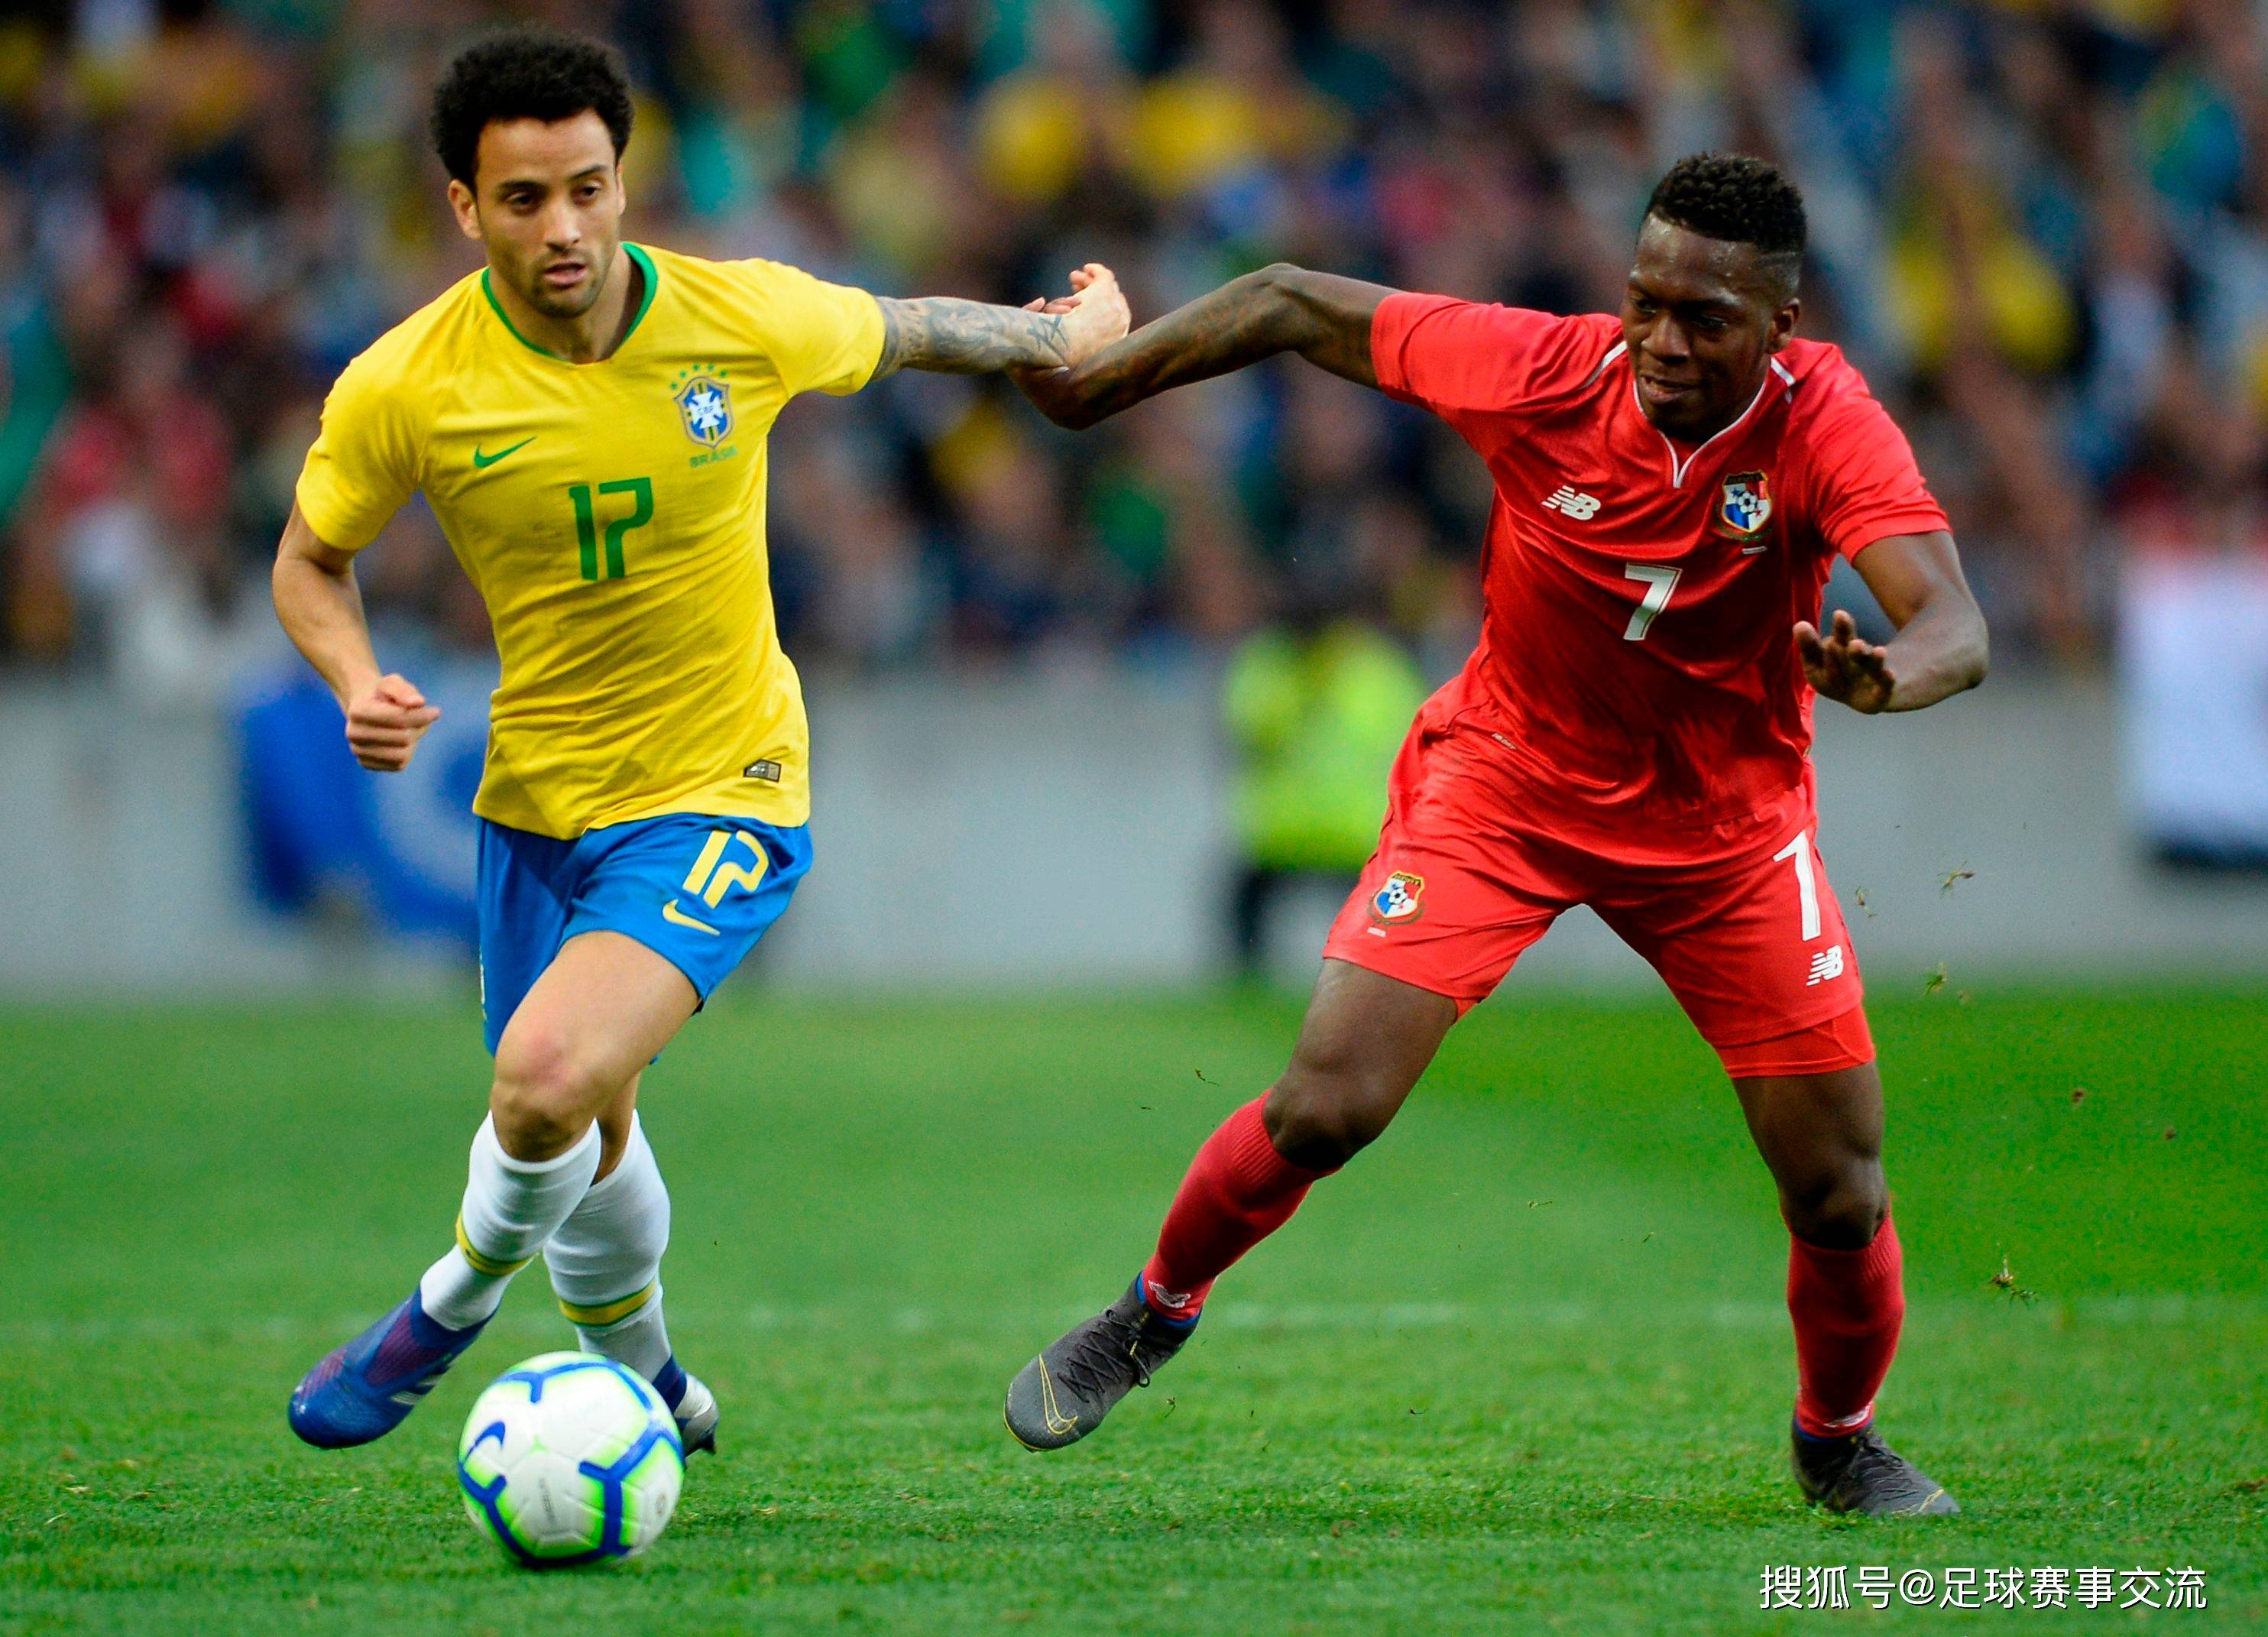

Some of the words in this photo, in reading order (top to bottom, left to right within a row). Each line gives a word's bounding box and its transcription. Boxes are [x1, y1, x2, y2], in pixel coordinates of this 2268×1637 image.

[568, 477, 654, 581] 17
[1622, 562, 1683, 641] 7
[682, 829, 770, 909] 17
[1773, 829, 1821, 942] 7
